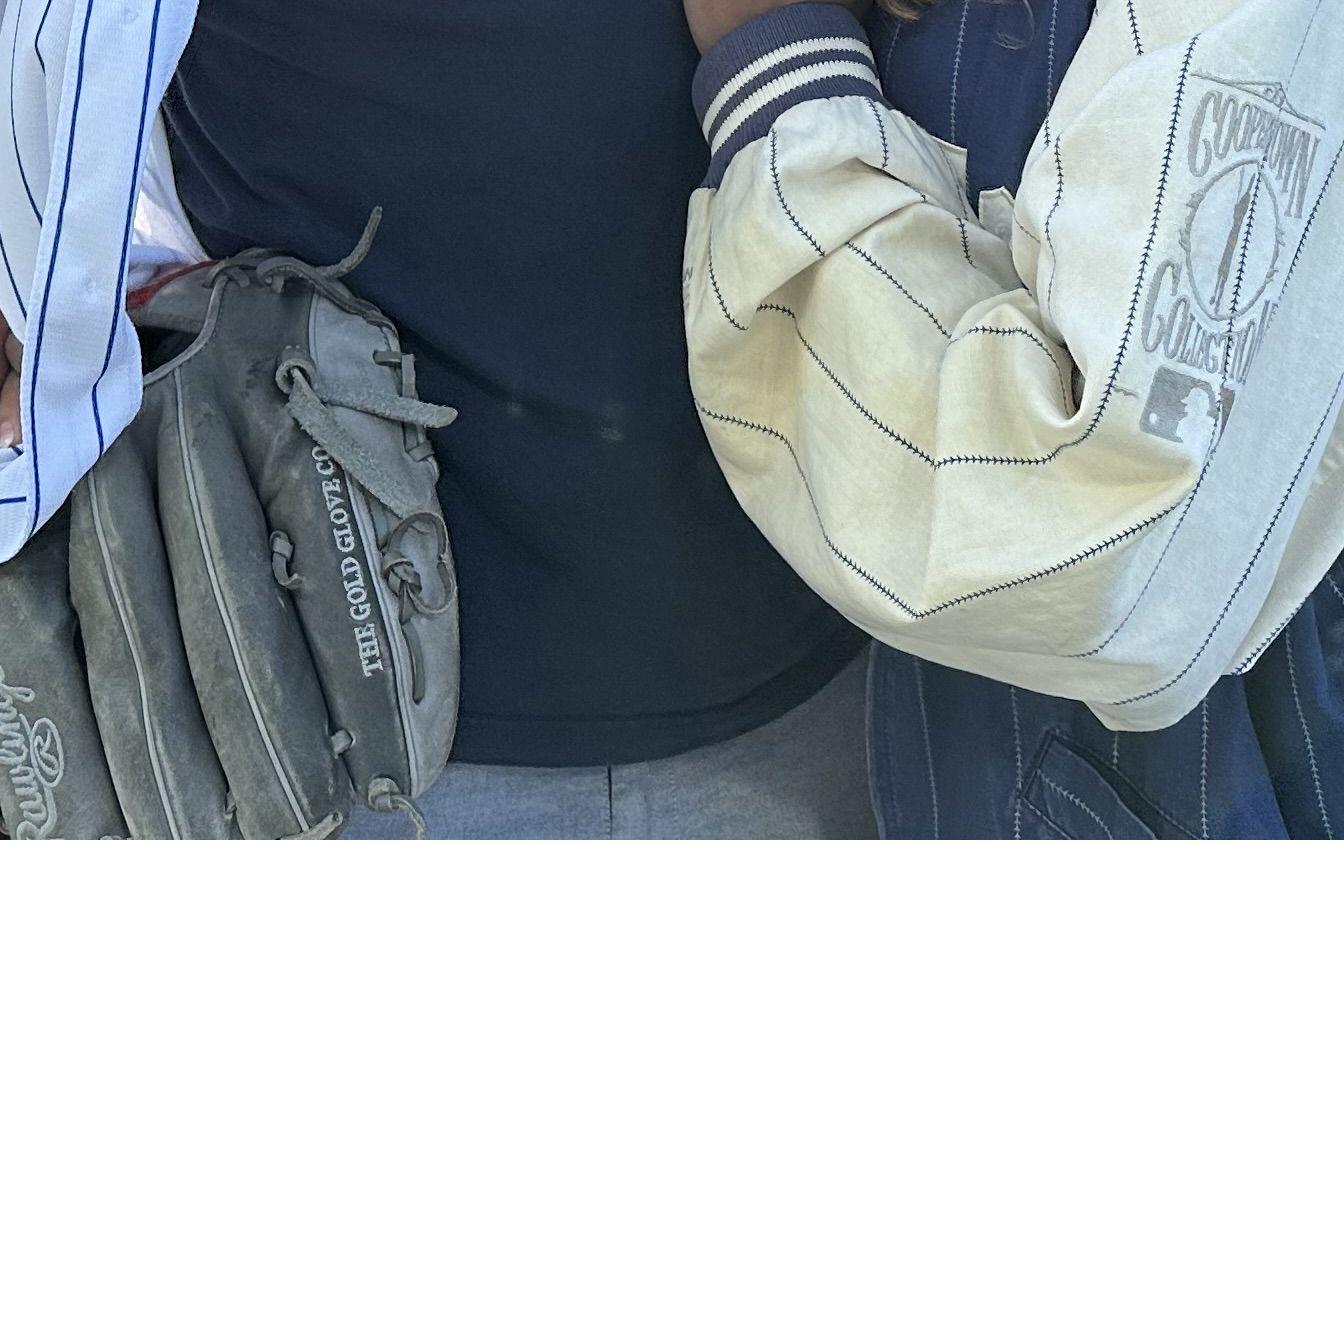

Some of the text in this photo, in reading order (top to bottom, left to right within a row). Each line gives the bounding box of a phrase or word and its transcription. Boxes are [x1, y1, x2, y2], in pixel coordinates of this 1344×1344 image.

[321, 477, 356, 553] GLOVE
[340, 556, 372, 622] GOLD
[353, 622, 384, 678] THE
